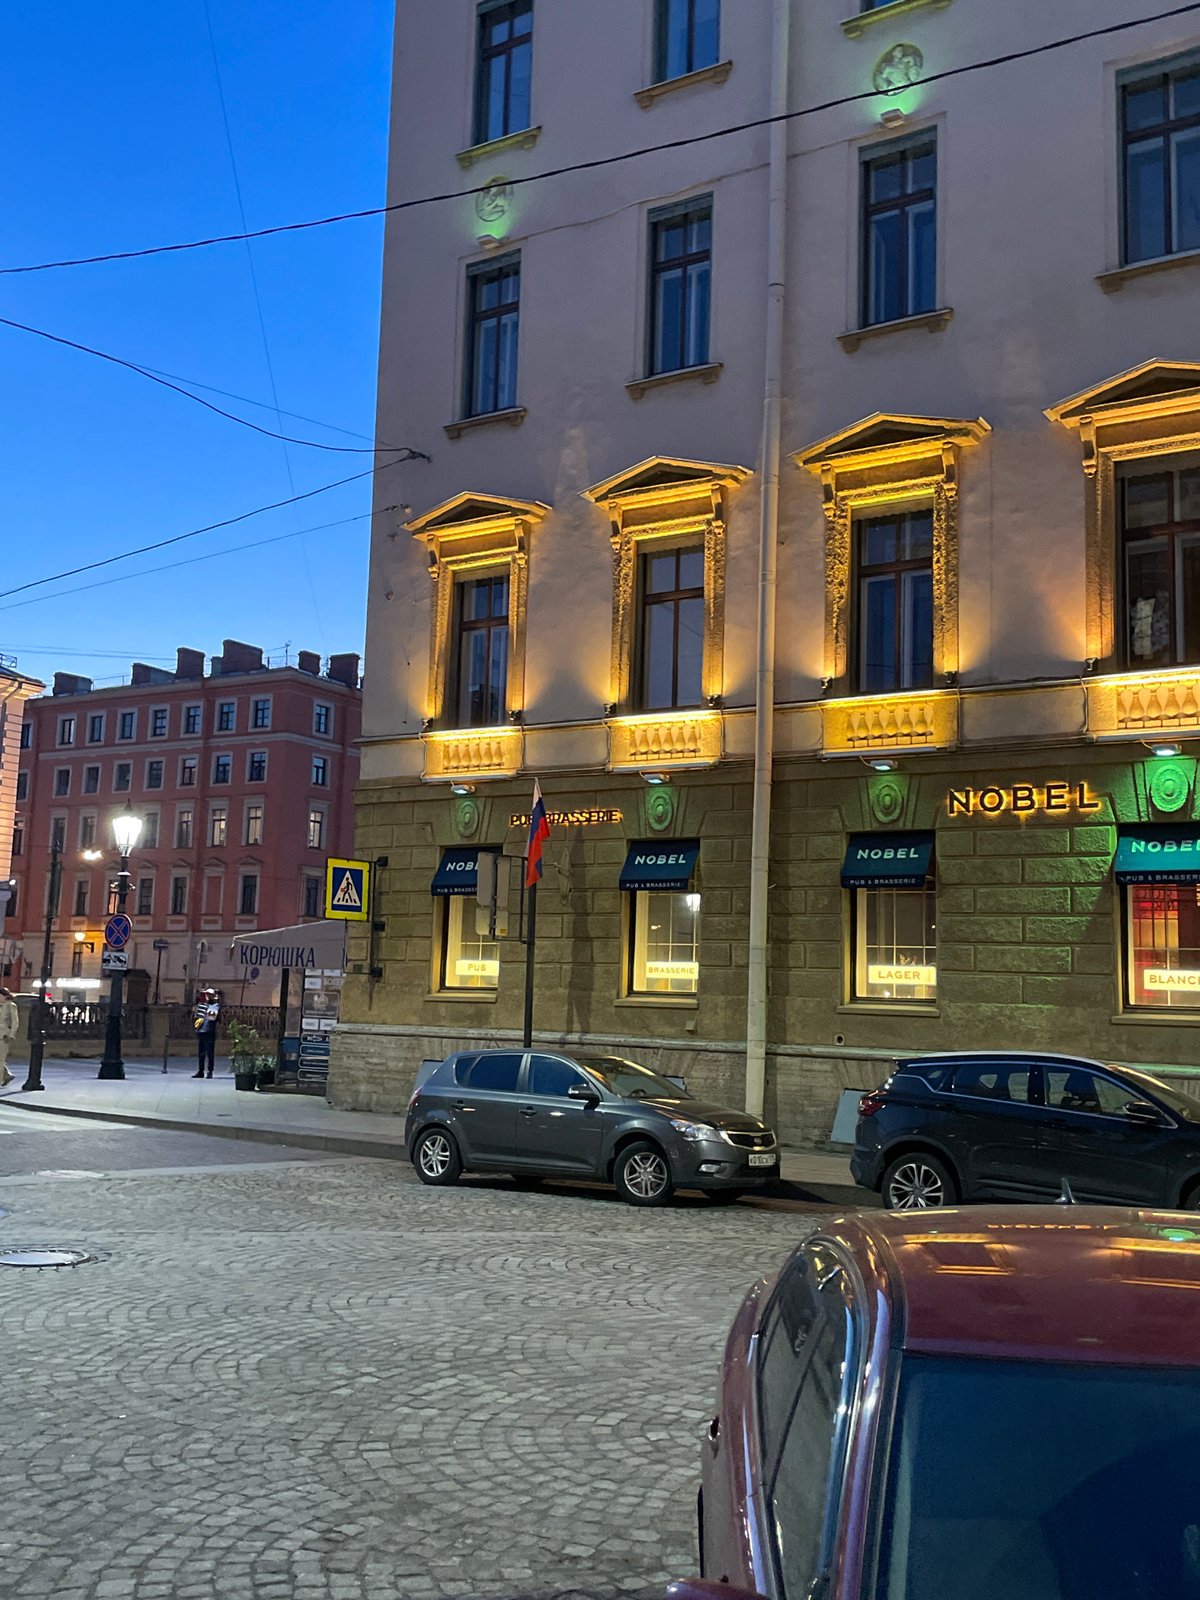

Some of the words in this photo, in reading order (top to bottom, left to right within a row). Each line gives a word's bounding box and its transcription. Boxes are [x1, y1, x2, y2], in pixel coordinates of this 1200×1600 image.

[948, 782, 1099, 815] NOBEL
[545, 809, 619, 825] BRASSERIE
[634, 853, 686, 865] NOBEL
[856, 847, 919, 860] NOBEL
[240, 944, 316, 968] КОРЮШКА
[467, 963, 487, 972] PUB
[648, 966, 695, 975] BRASSERIE
[878, 970, 921, 980] LAGER
